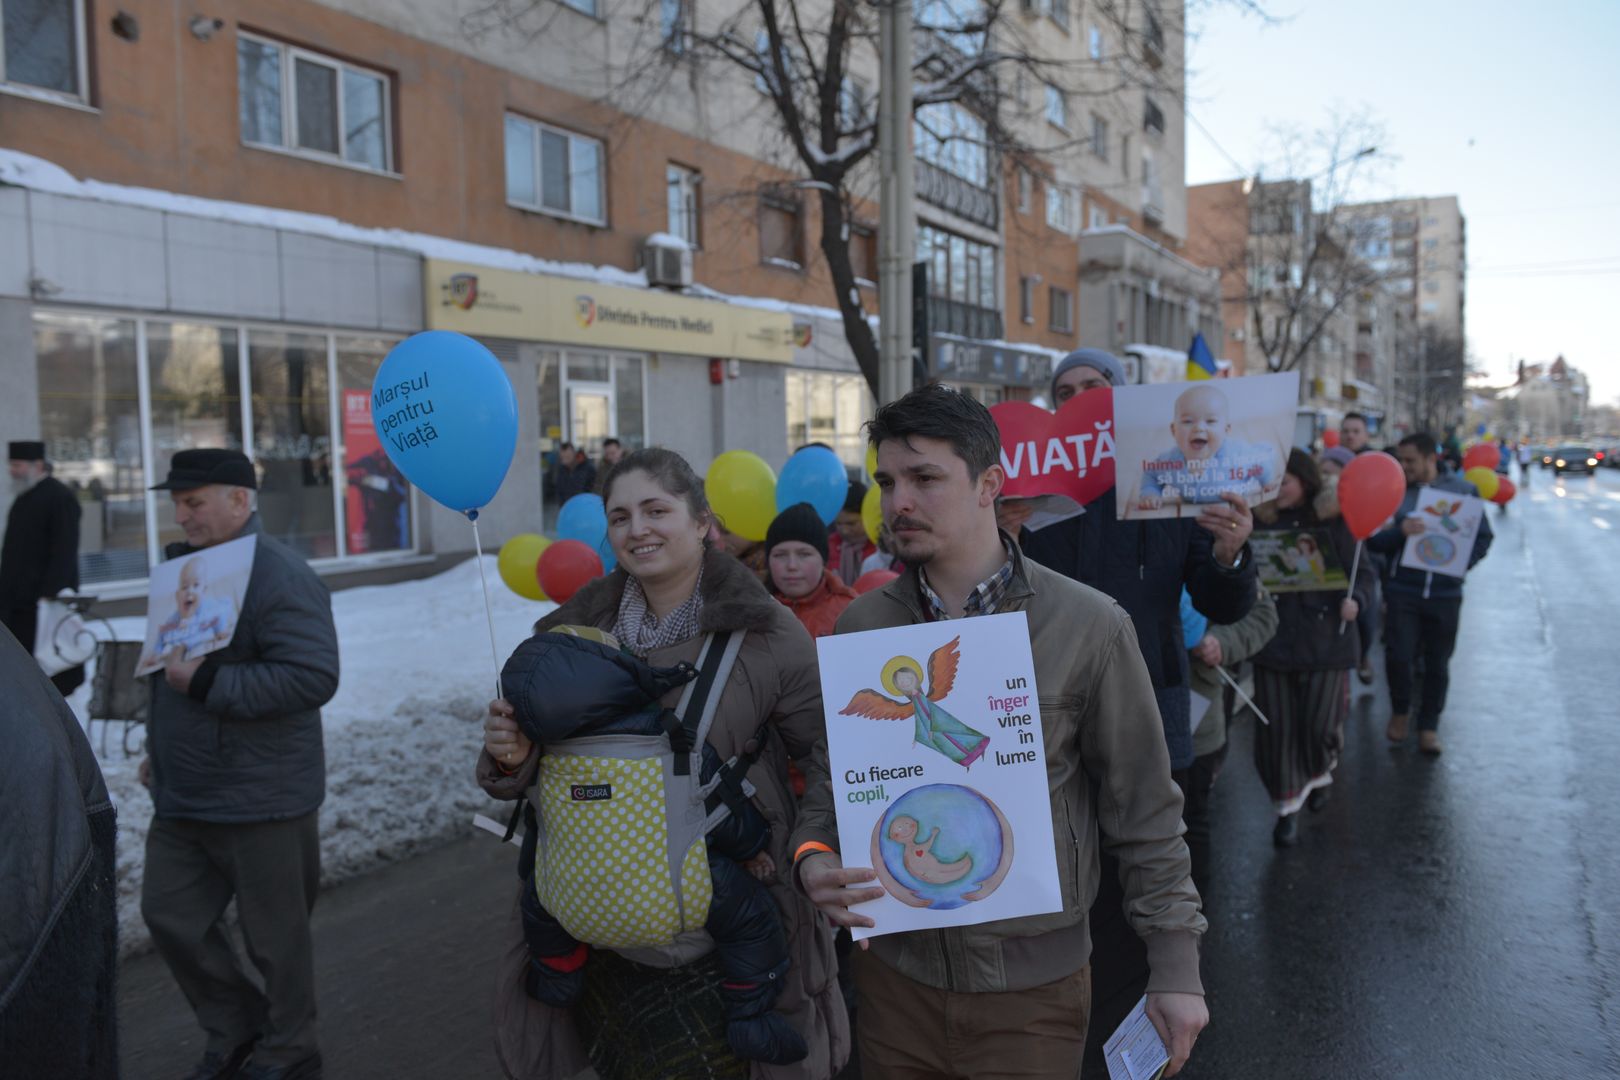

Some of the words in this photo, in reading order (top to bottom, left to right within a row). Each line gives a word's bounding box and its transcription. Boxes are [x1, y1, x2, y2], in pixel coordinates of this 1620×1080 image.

[374, 371, 429, 410] Marșul
[381, 399, 434, 438] pentru
[391, 421, 438, 452] Viață
[1000, 419, 1116, 479] VIAȚĂ
[1142, 459, 1184, 472] Inima
[1187, 457, 1219, 470] mea
[1213, 469, 1225, 482] la
[1229, 466, 1244, 481] 16
[1162, 485, 1180, 498] de
[1184, 484, 1196, 498] la
[1006, 677, 1027, 690] un
[988, 695, 1029, 713] înger
[997, 713, 1032, 728] vine
[1018, 729, 1034, 745] în
[996, 750, 1036, 766] lume
[845, 769, 866, 785] Cu
[869, 765, 924, 782] fiecare
[586, 788, 608, 798] ISARA
[847, 784, 889, 805] copil,
